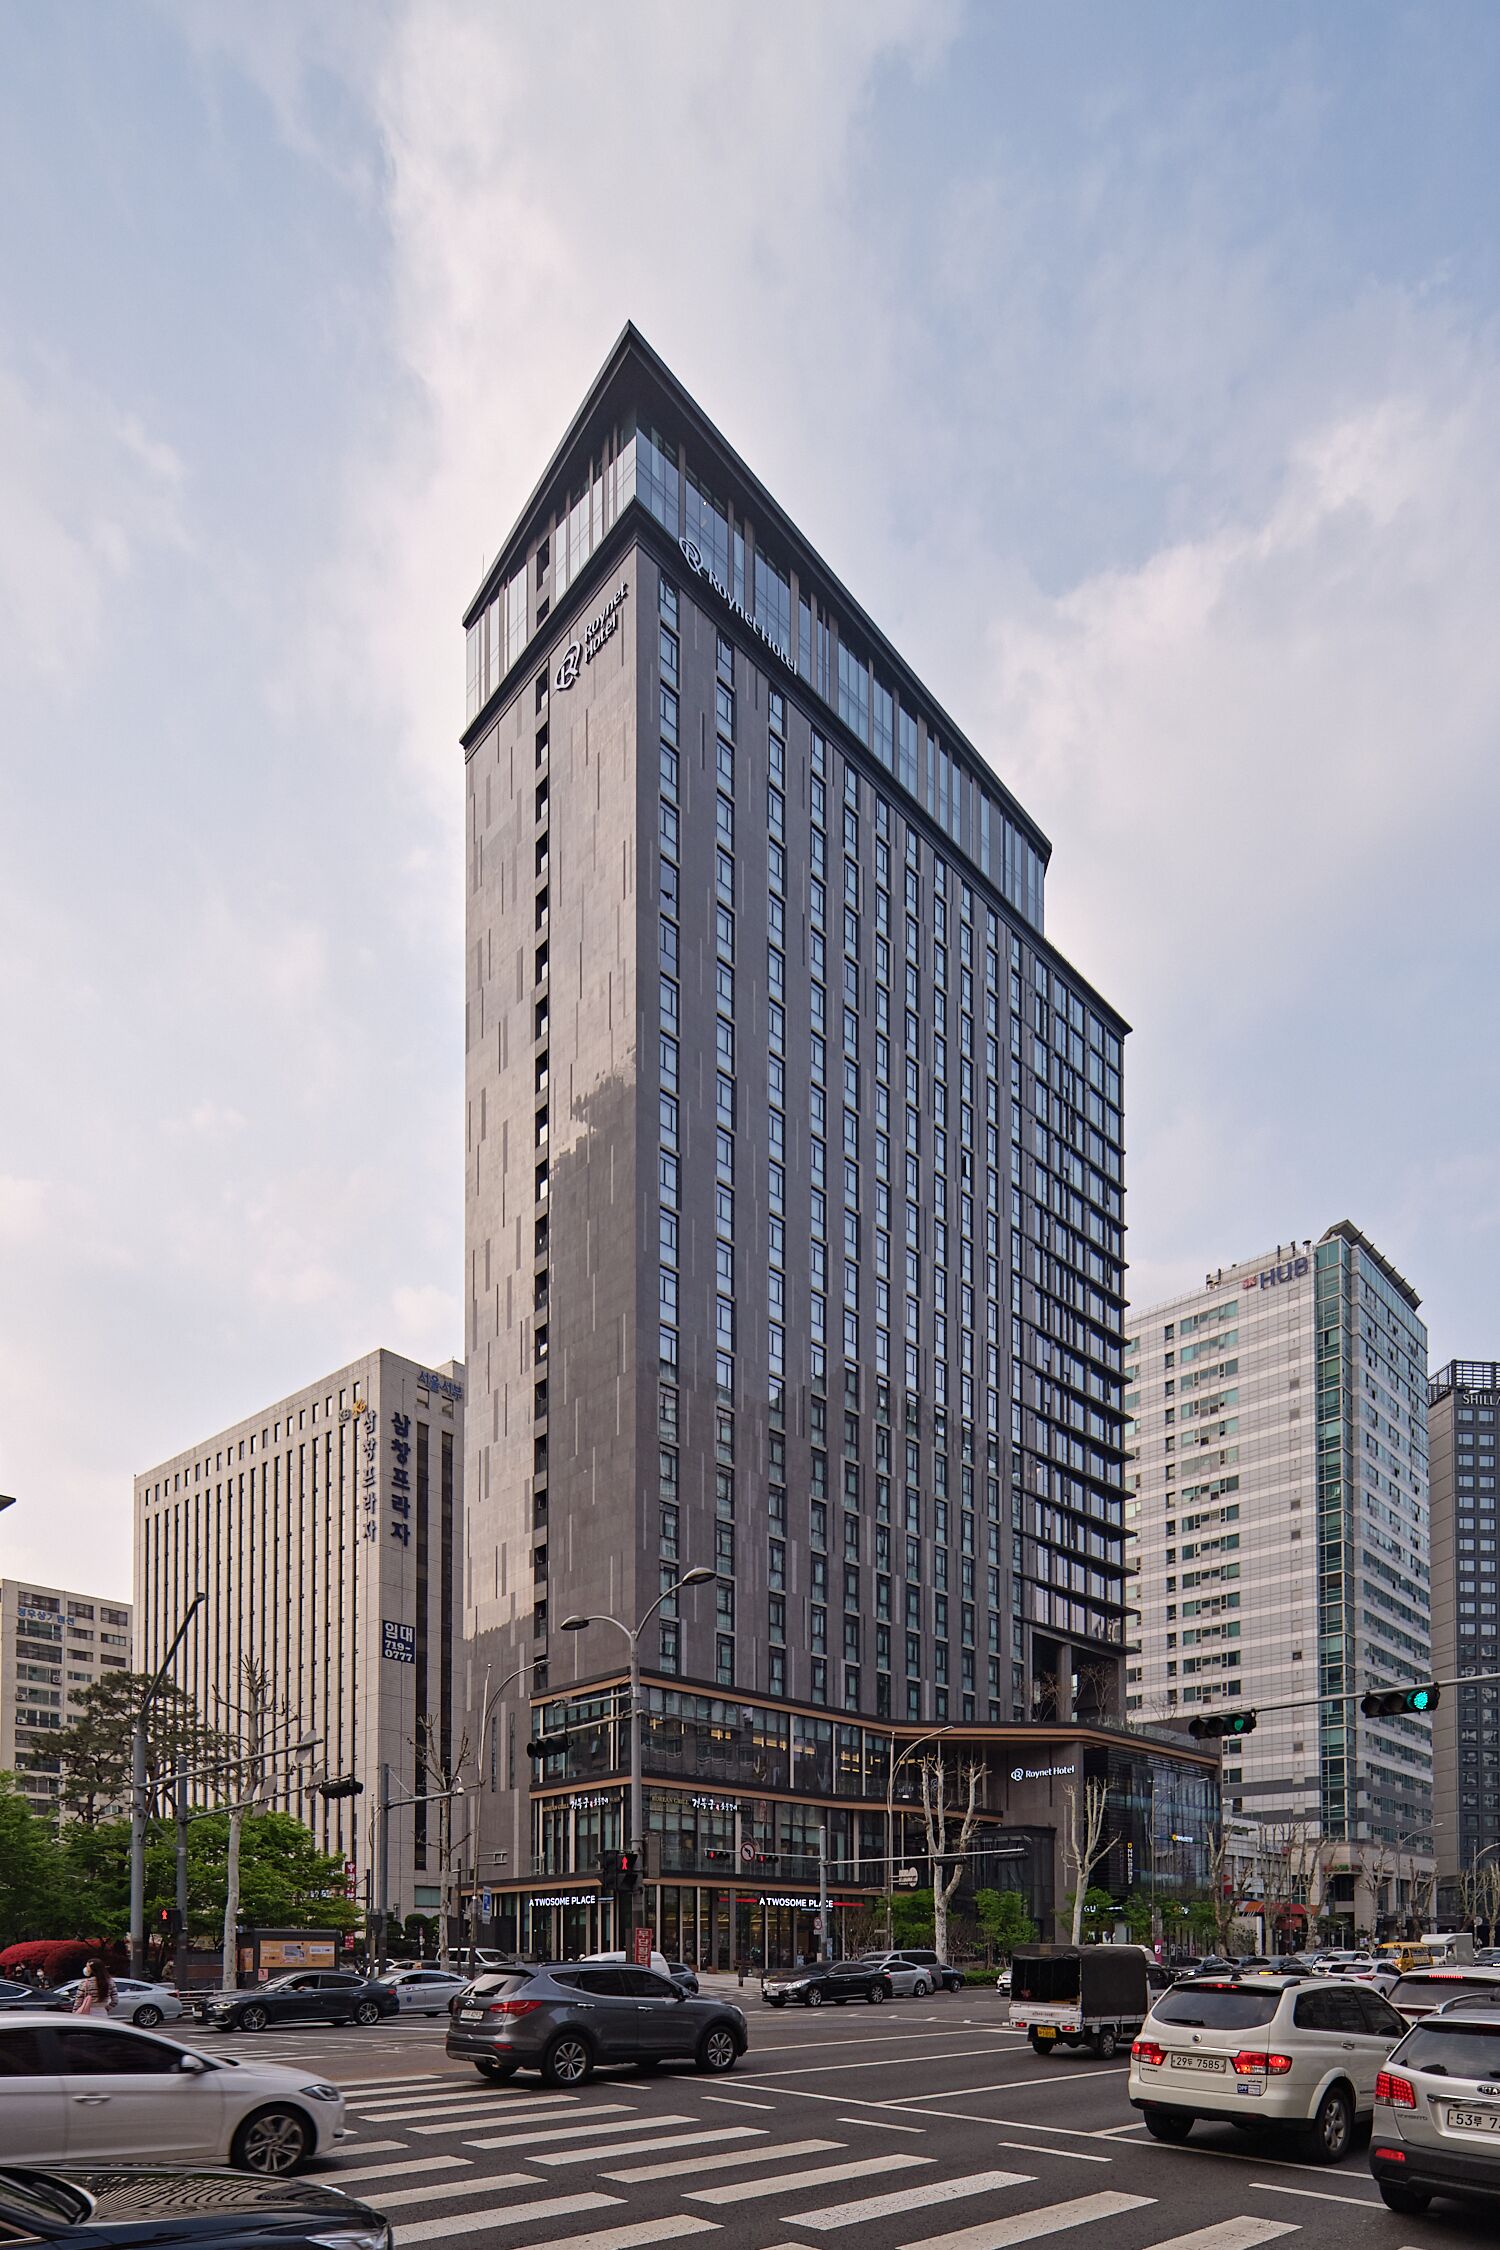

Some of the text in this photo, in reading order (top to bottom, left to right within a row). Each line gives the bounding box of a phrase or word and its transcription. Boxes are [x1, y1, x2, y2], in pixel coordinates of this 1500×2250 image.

[585, 582, 628, 664] Roynet Hotel
[708, 568, 797, 675] Roynet Hotel
[1260, 1257, 1308, 1290] HUB
[390, 1411, 411, 1547] 삼창프라자
[385, 1622, 413, 1643] 임대
[385, 1640, 411, 1651] 719-
[385, 1649, 412, 1662] 0777
[1025, 1765, 1075, 1779] Roynet Hotel
[529, 1899, 534, 1907] A
[535, 1897, 570, 1906] TWOSOME
[571, 1895, 596, 1905] PLACE
[759, 1898, 765, 1906] A
[766, 1898, 806, 1907] TWOSOME
[1196, 2059, 1220, 2070] 7585
[1481, 2086, 1498, 2095] KIA
[1456, 2113, 1500, 2129] 53루 7
